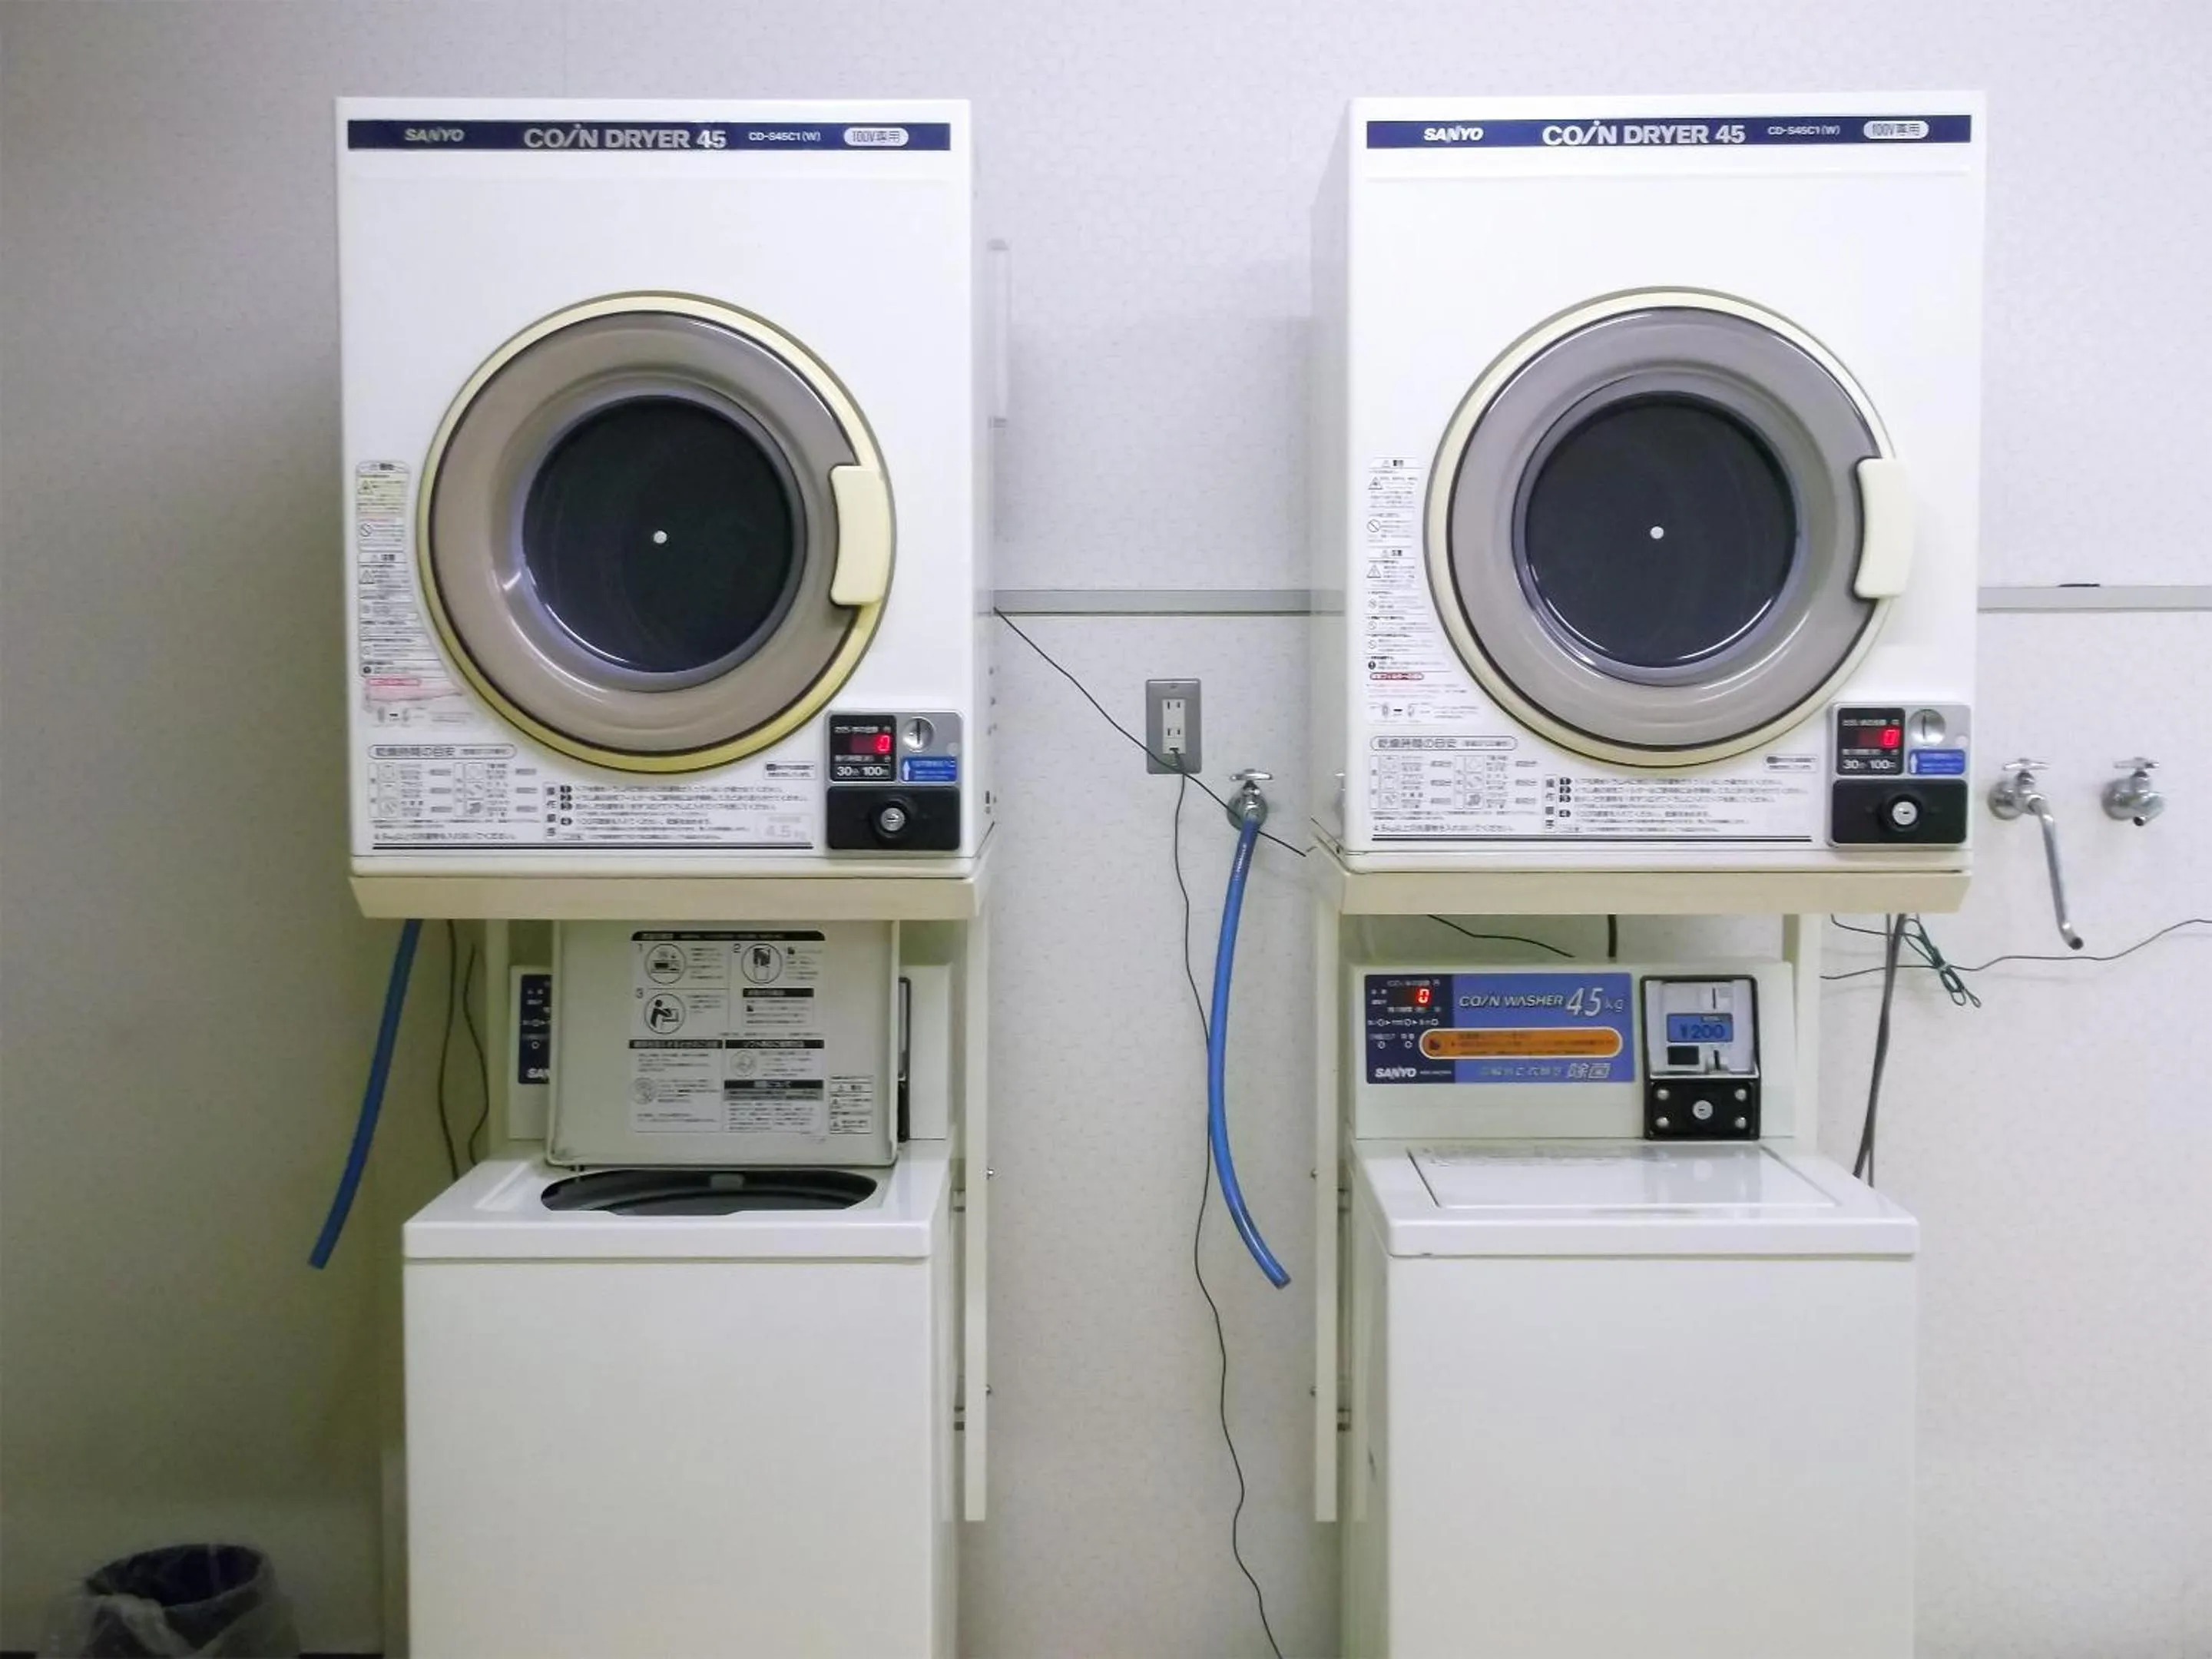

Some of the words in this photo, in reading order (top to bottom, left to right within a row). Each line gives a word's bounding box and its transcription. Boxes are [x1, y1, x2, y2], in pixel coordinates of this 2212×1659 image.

[404, 127, 466, 143] SANYO
[605, 129, 690, 148] DRYER
[697, 130, 727, 148] 45
[1423, 125, 1484, 143] SANYO
[1624, 124, 1709, 144] DRYER
[1715, 124, 1747, 144] 45
[1504, 994, 1564, 1007] WASHER
[1375, 1065, 1417, 1080] SANYO
